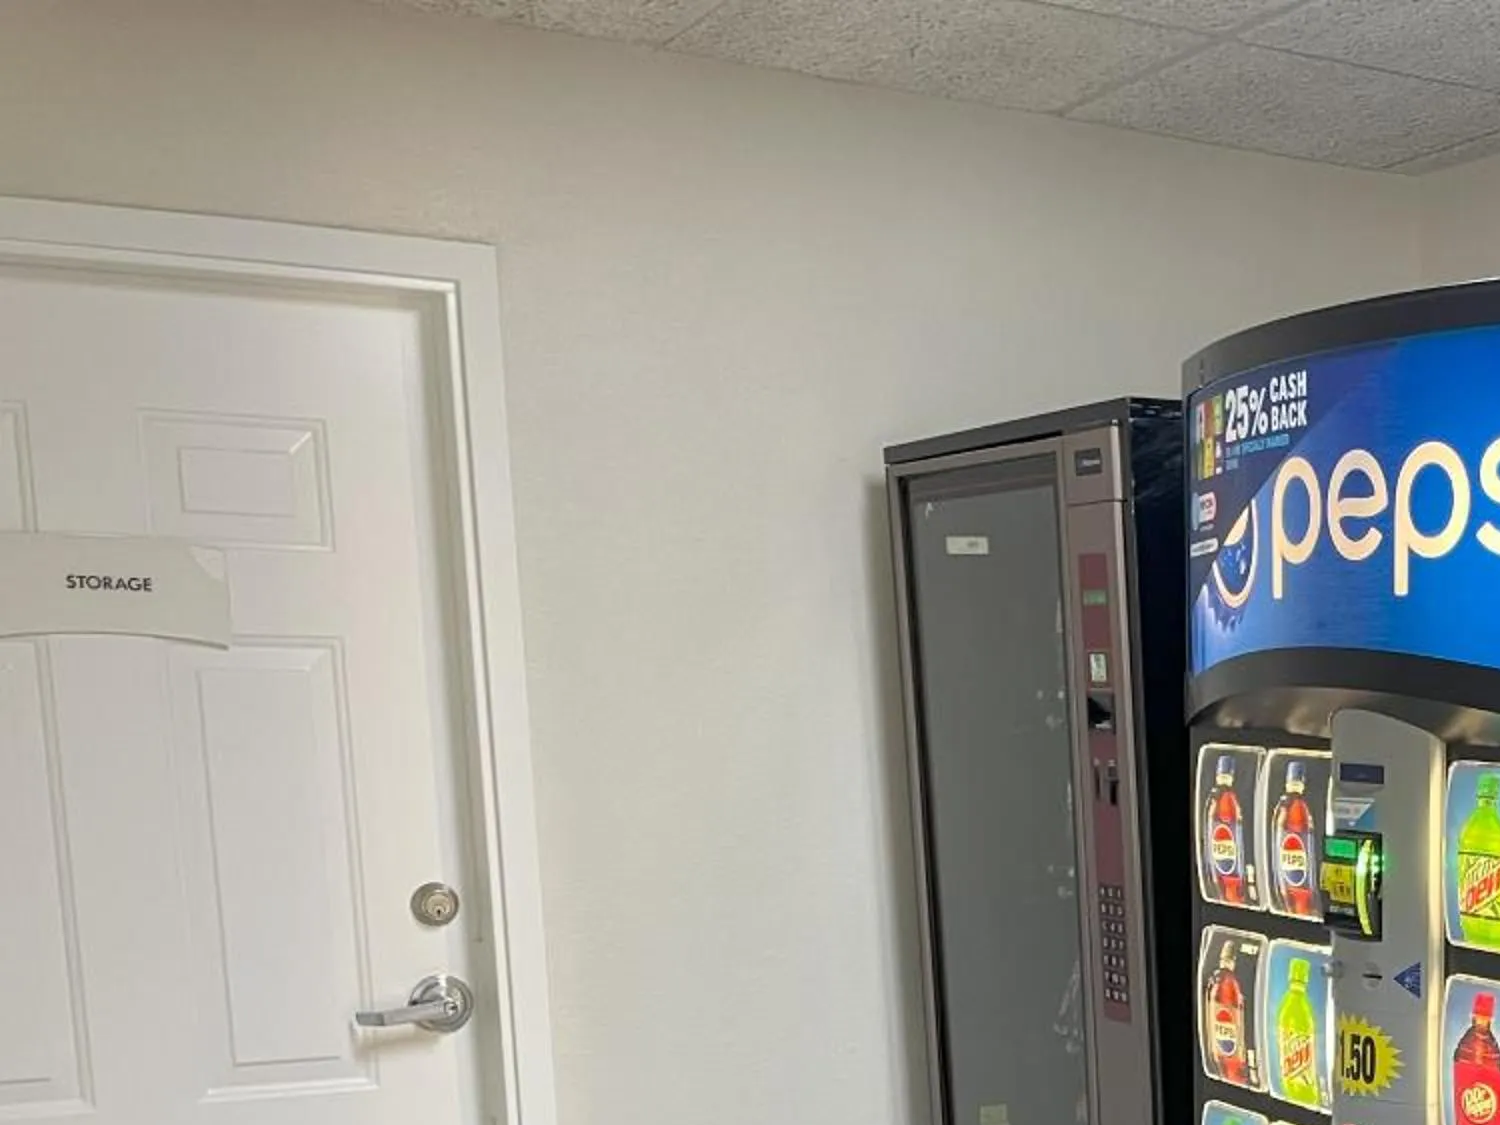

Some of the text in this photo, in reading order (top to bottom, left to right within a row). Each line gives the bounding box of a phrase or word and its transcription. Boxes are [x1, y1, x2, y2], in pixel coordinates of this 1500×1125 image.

[1269, 370, 1307, 403] CASH
[1225, 384, 1269, 443] 25%
[1271, 399, 1307, 432] BACK
[66, 574, 153, 592] STORAGE
